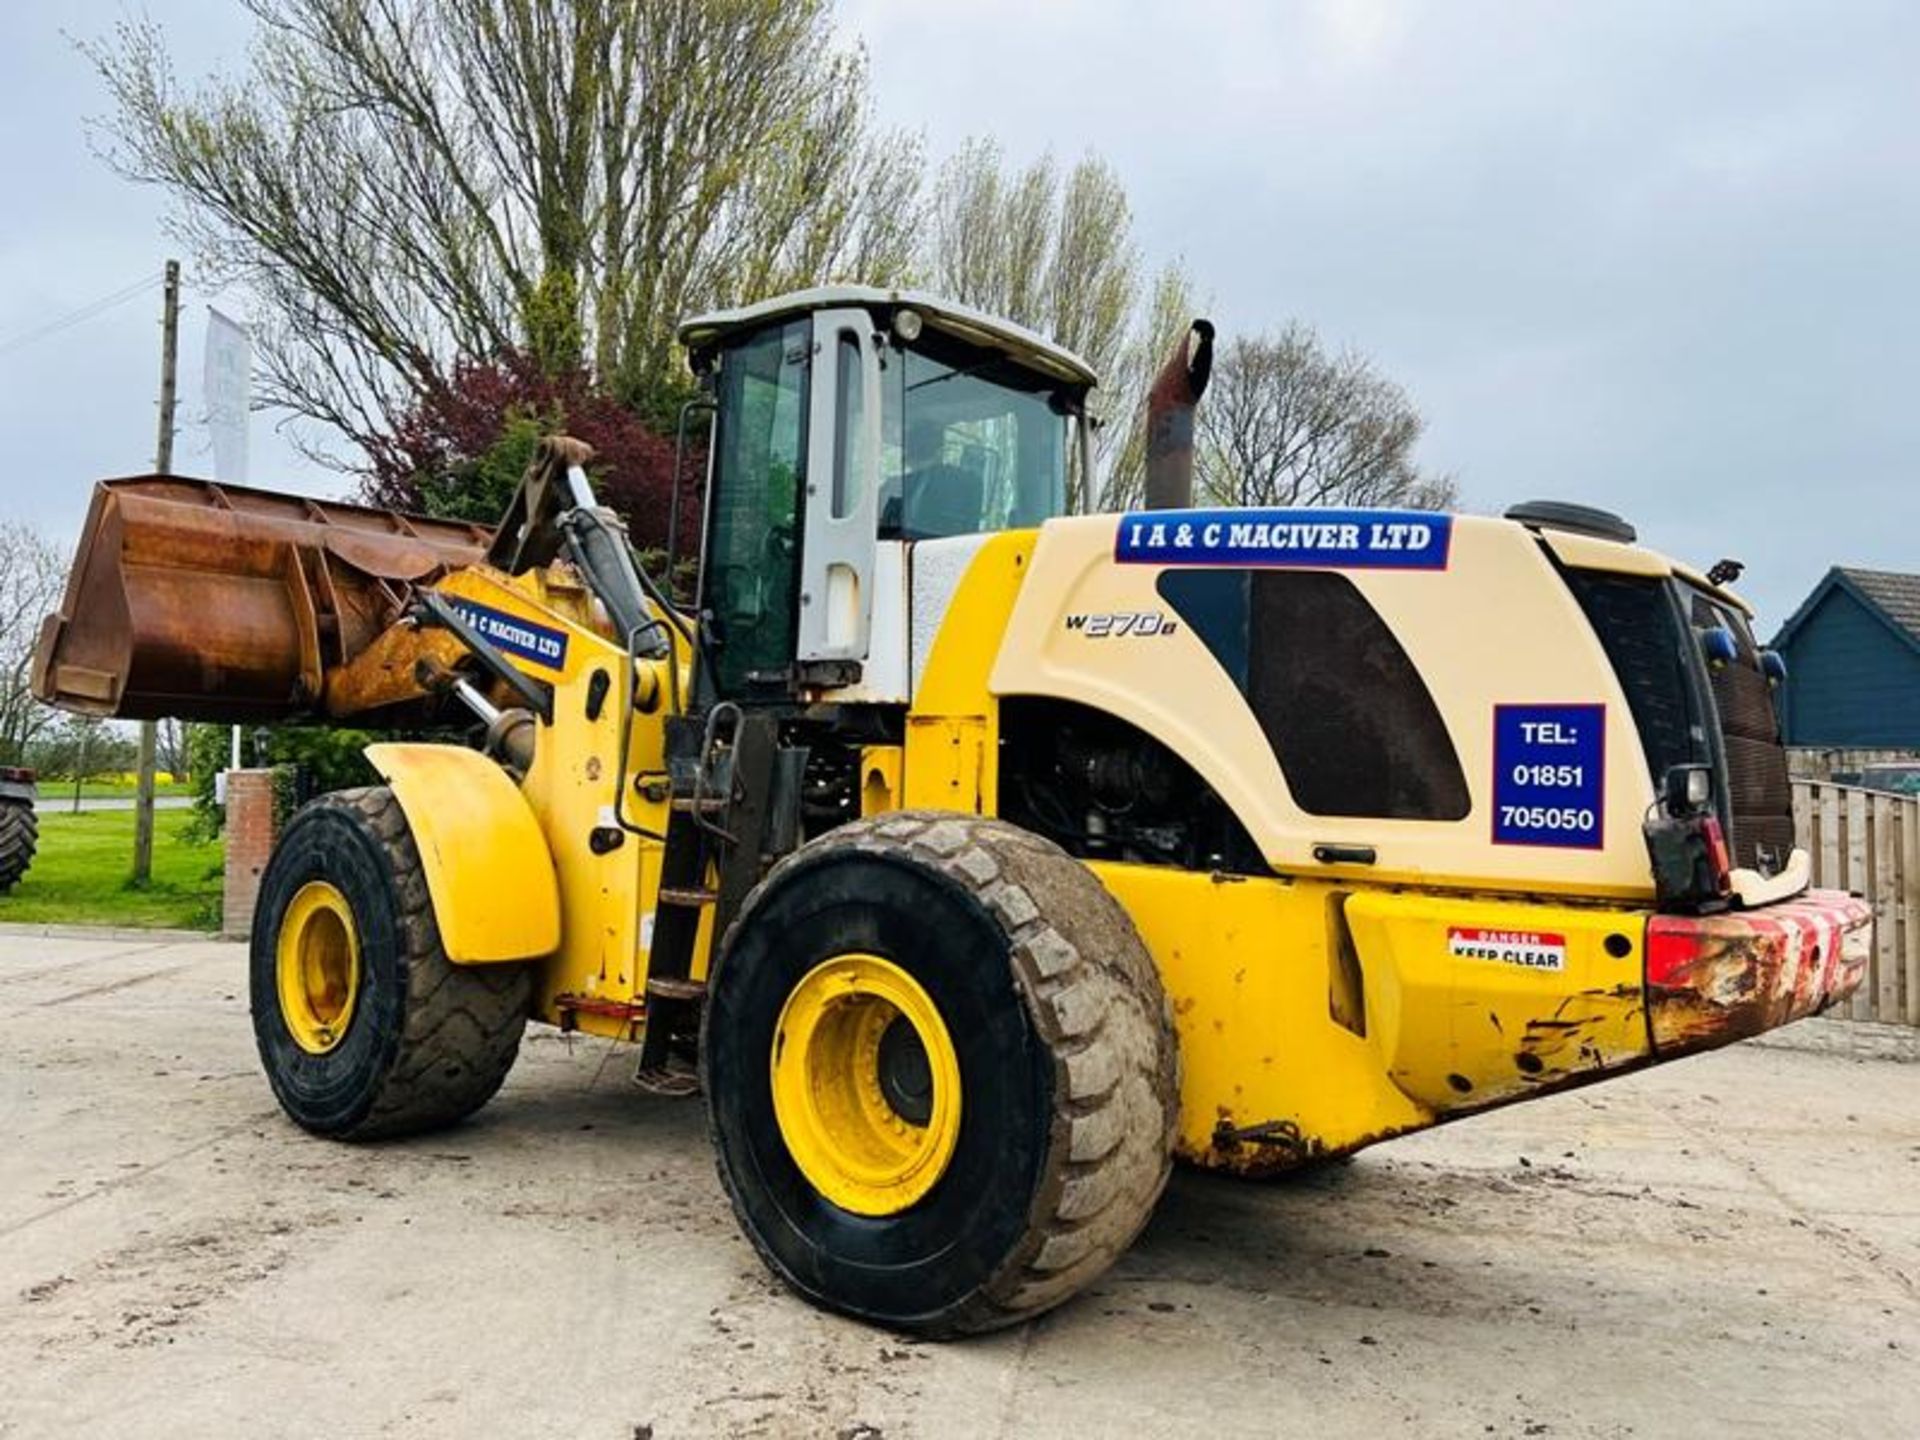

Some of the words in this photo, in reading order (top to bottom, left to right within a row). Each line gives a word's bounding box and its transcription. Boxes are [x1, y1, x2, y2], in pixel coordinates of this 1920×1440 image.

[1130, 524, 1143, 547] I
[1147, 524, 1166, 547] A
[1173, 523, 1194, 548] &
[1203, 524, 1221, 548] C
[1228, 524, 1359, 549] MACIVER
[1369, 524, 1431, 550] LTD
[479, 616, 487, 632] C
[488, 620, 536, 650] MACIVER
[537, 636, 560, 657] LTD
[1520, 723, 1577, 744] TEL:
[1513, 765, 1582, 787] 01851
[1501, 806, 1594, 830] 705050
[1477, 931, 1540, 944] DANGER
[1502, 949, 1559, 968] CLEAR
